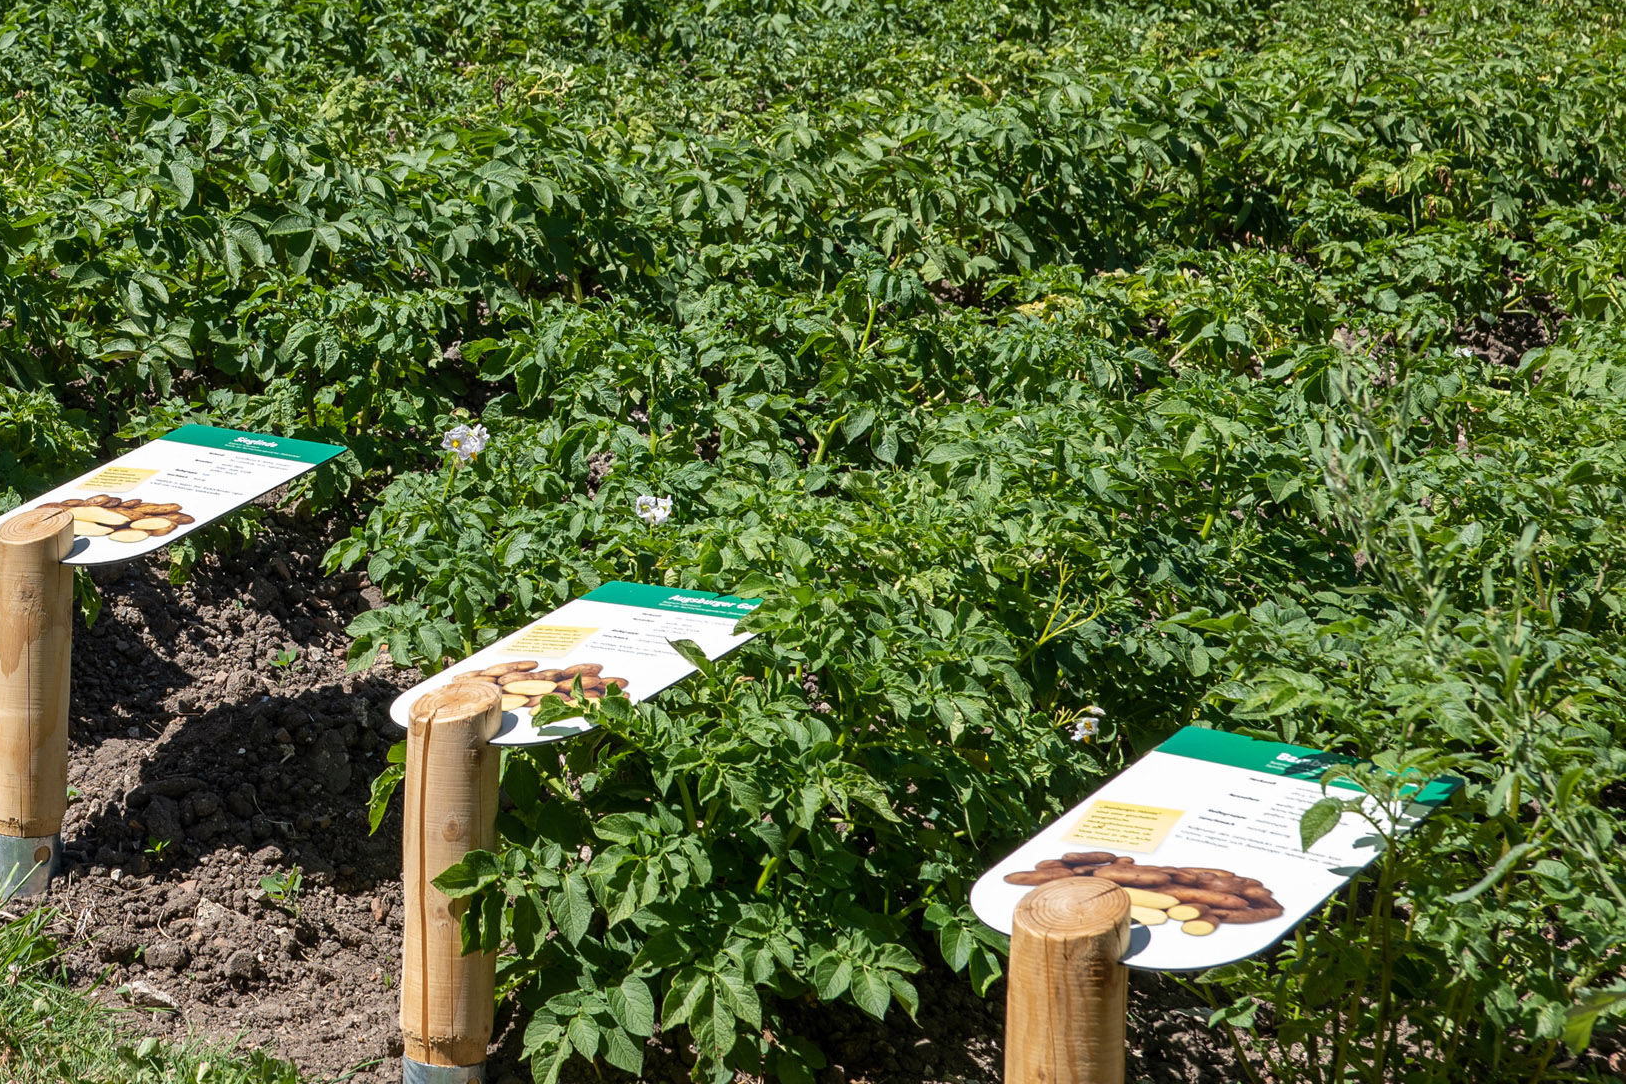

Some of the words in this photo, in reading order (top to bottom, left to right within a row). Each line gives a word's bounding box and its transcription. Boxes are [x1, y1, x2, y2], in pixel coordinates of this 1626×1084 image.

[233, 436, 278, 448] Sieglinde
[668, 594, 737, 609] Augsburger
[736, 601, 760, 611] Gol
